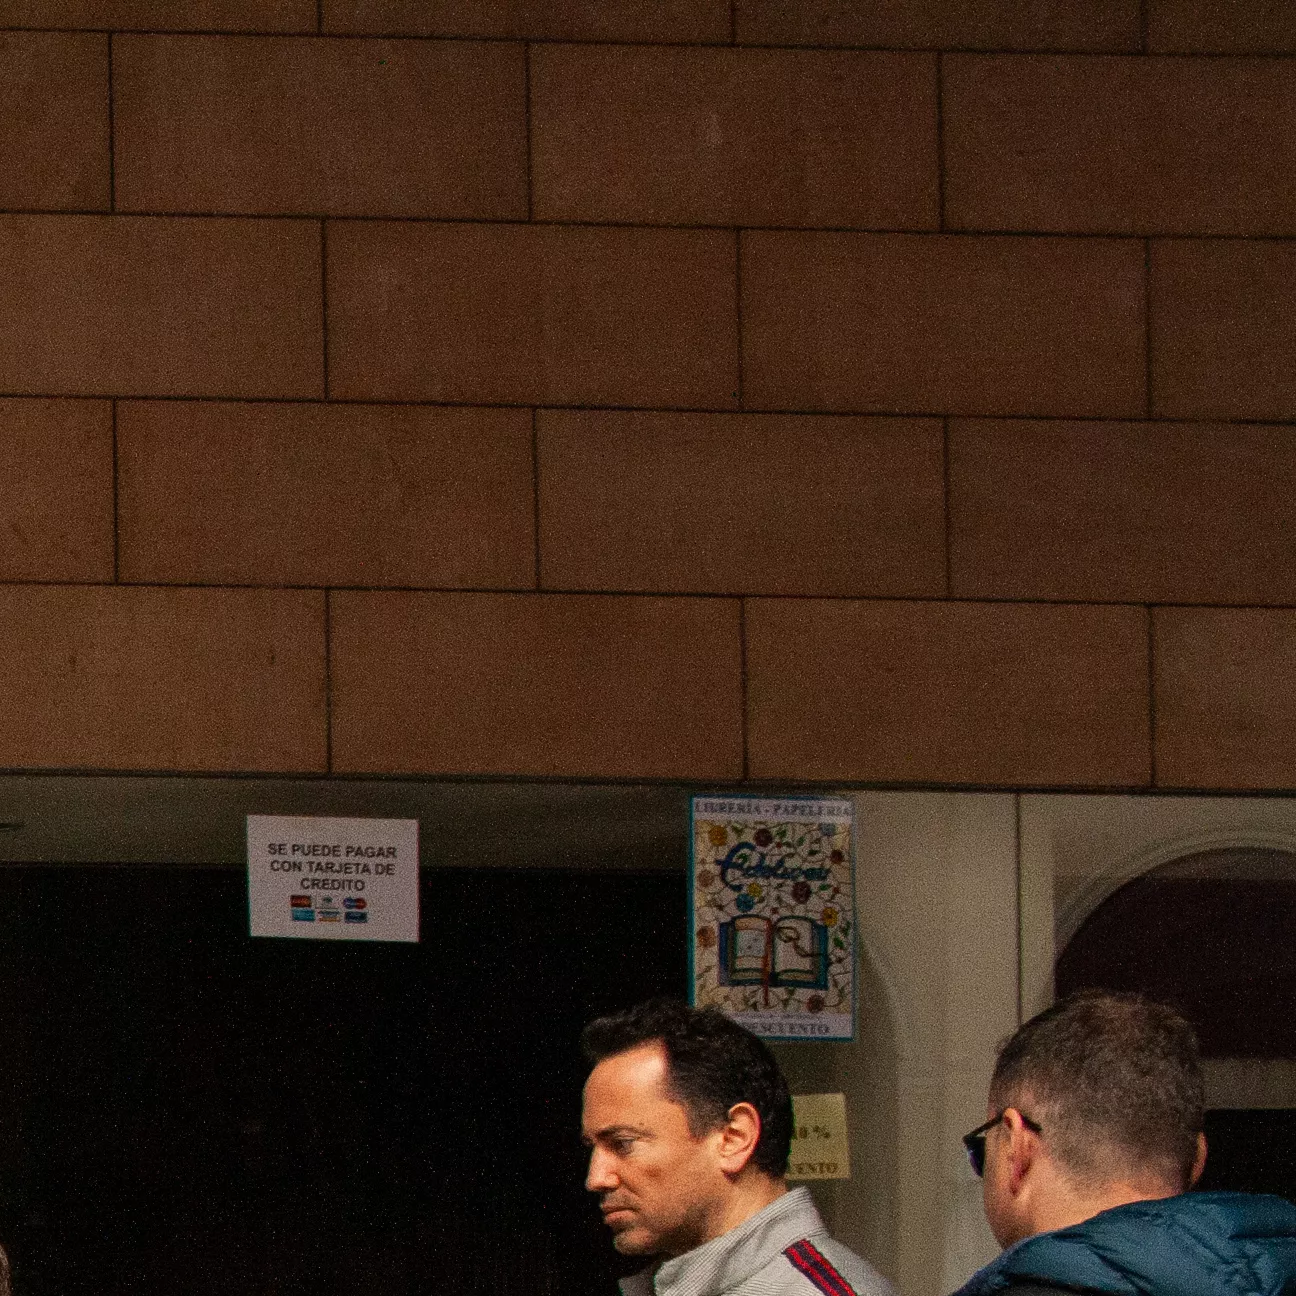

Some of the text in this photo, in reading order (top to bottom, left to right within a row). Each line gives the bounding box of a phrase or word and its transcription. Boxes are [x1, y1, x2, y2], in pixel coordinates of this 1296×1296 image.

[268, 843, 397, 859] SE PUEDE PAGAR
[270, 860, 395, 875] CON TARJETA DE
